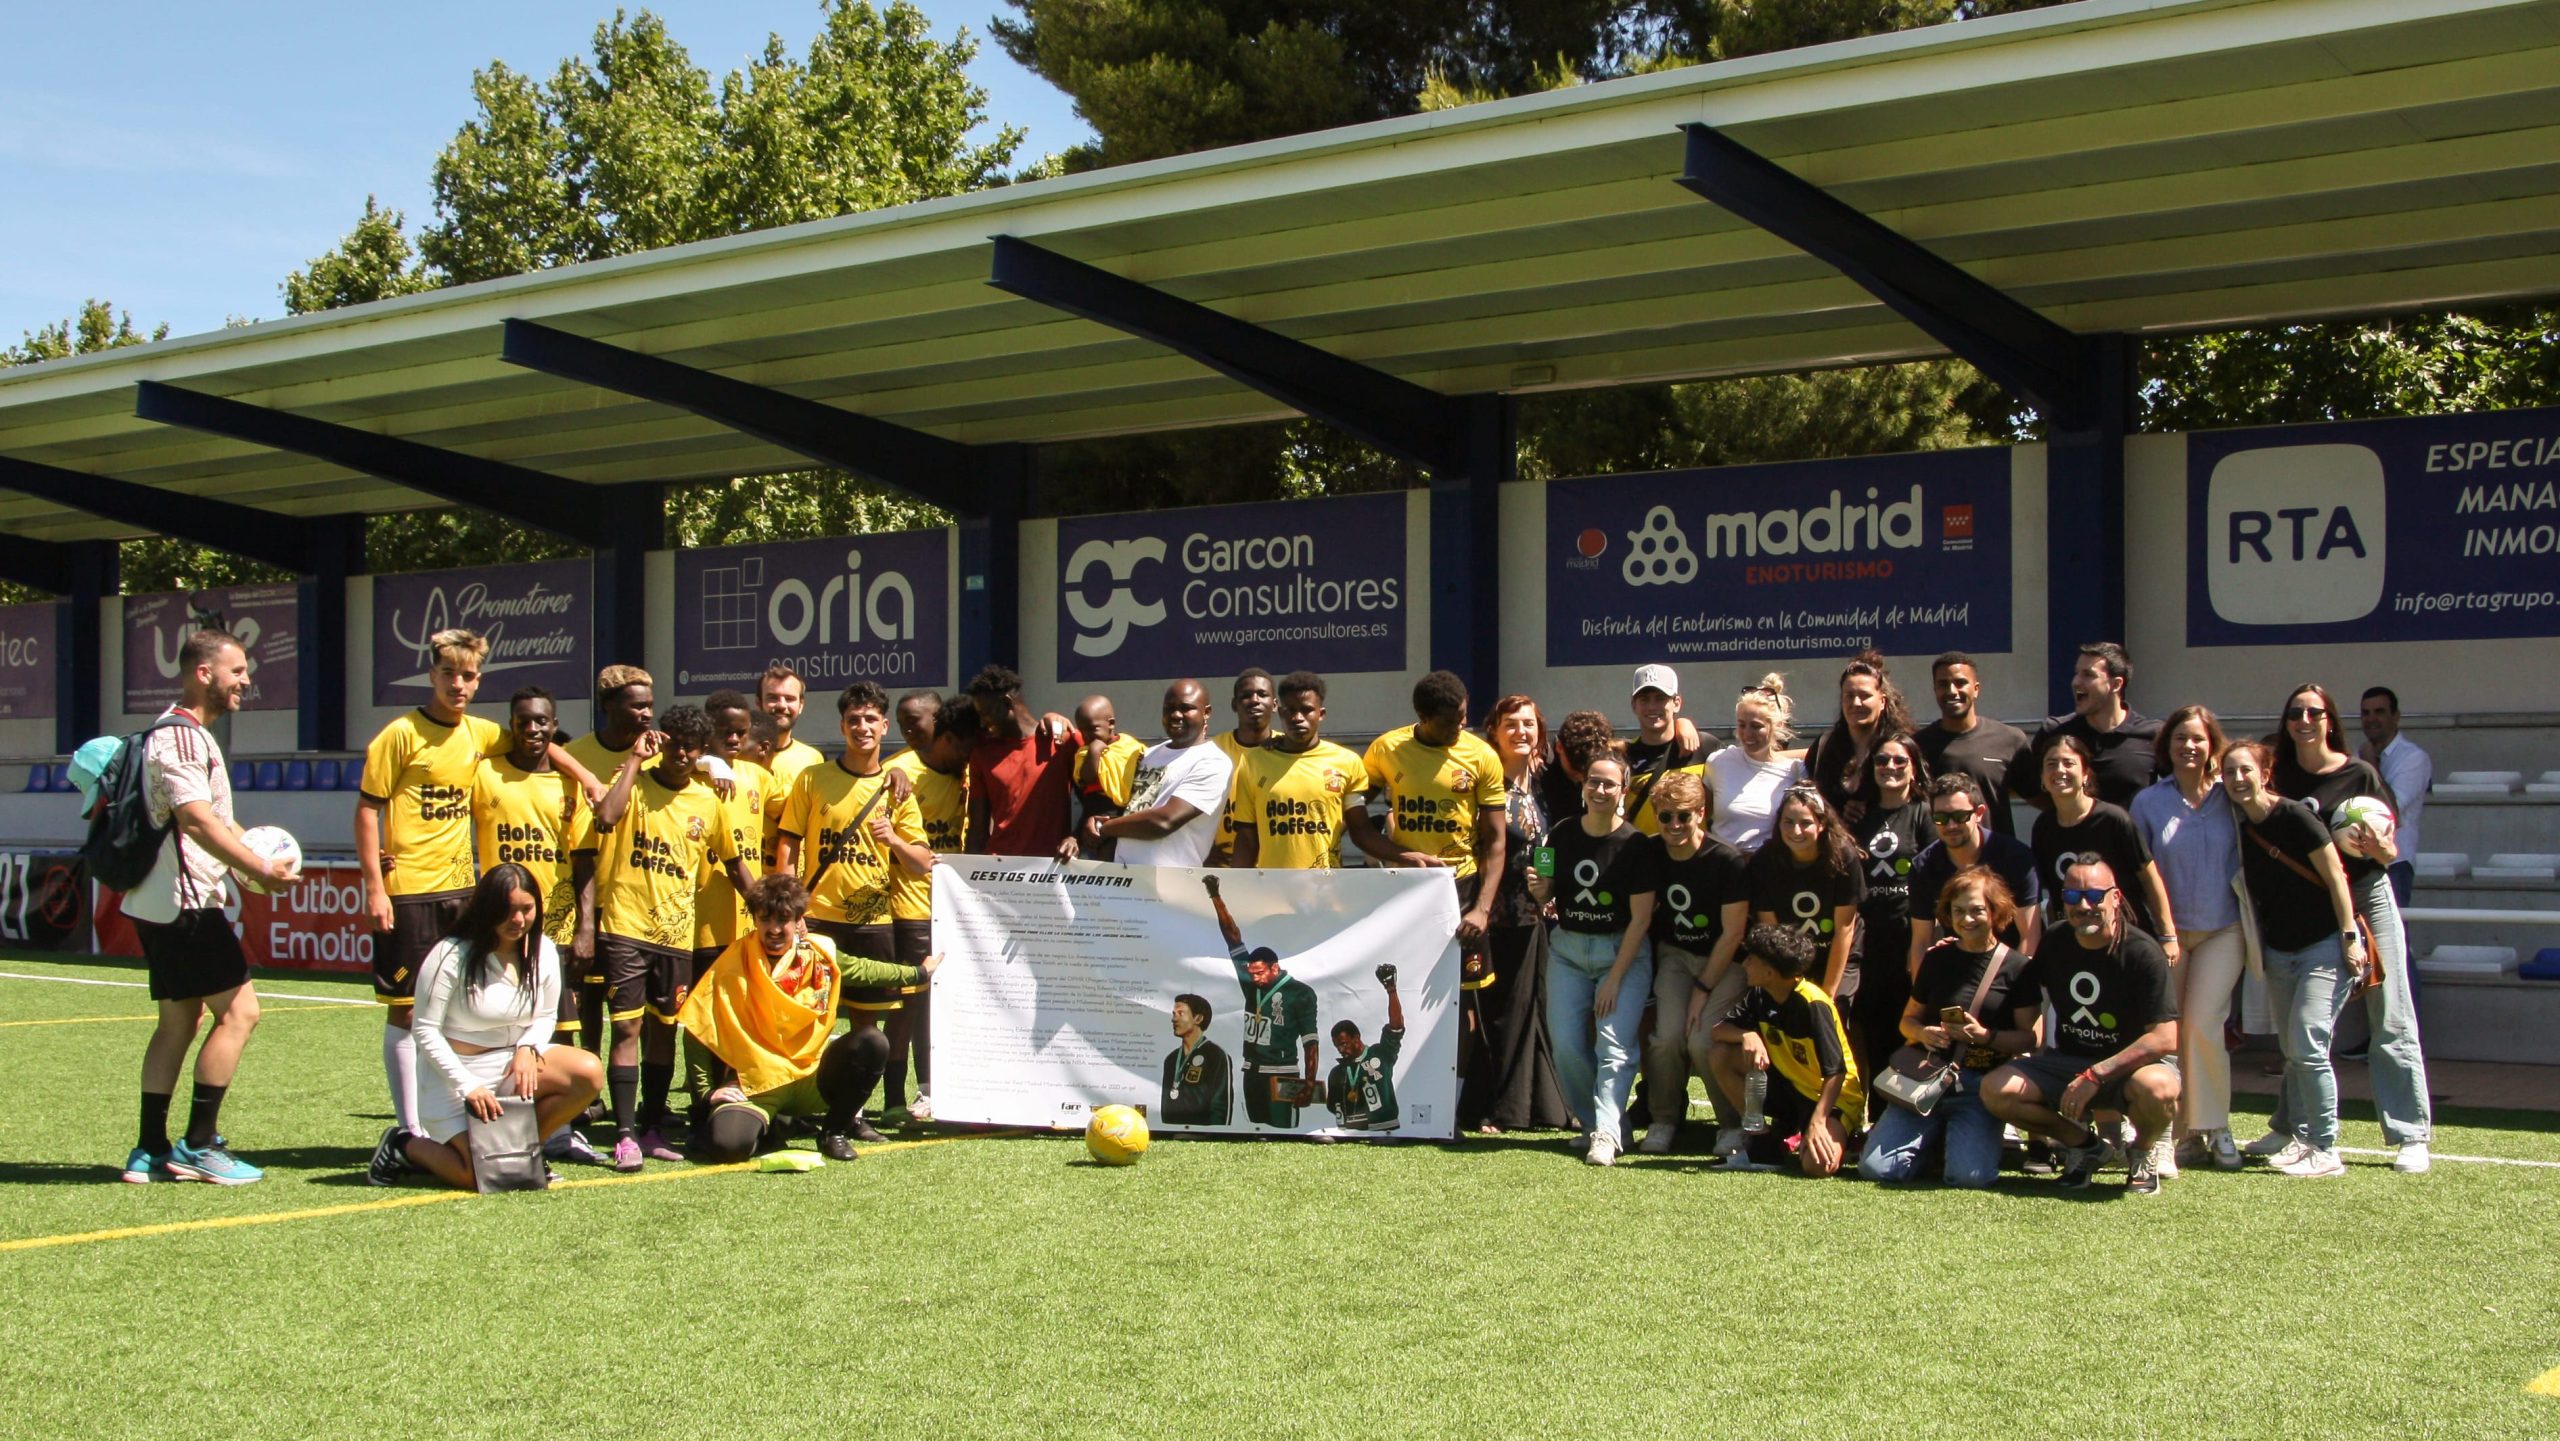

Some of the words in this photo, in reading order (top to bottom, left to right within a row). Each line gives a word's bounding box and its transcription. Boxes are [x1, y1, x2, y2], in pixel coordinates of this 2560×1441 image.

[2455, 481, 2560, 515] MANA
[1706, 484, 1923, 559] madrid
[2229, 506, 2367, 564] RTA
[1182, 532, 1314, 574] Garcon
[2463, 524, 2560, 557] INMO
[1746, 559, 1894, 585] ENOTURISMO
[456, 582, 574, 626] Promotores
[768, 550, 915, 646] oria
[1183, 573, 1399, 619] Consultores
[1195, 622, 1388, 646] www.garconconsultores.es
[1582, 615, 1641, 637] Disfruta
[1646, 615, 1667, 636] del
[1673, 612, 1753, 635] Enoturismo
[1757, 615, 1775, 631] en
[1779, 612, 1794, 630] la
[1797, 604, 1880, 629] Comunidad
[1885, 606, 1904, 626] de
[1909, 602, 1969, 626] Madrid
[485, 621, 575, 664] Inversión
[1668, 635, 1872, 654] www.madridenoturismo.org
[769, 645, 915, 678] construcción
[1266, 798, 1308, 818] Hola
[1398, 795, 1438, 813] Hola
[497, 823, 544, 842] Hola
[1398, 812, 1463, 833] Coffee.
[498, 843, 567, 864] Coffee.
[633, 830, 671, 856] Hola
[630, 850, 689, 881] Coffee.
[969, 870, 1026, 882] GESTOS
[1029, 873, 1058, 884] QUE
[1060, 873, 1133, 888] IMPORTAN
